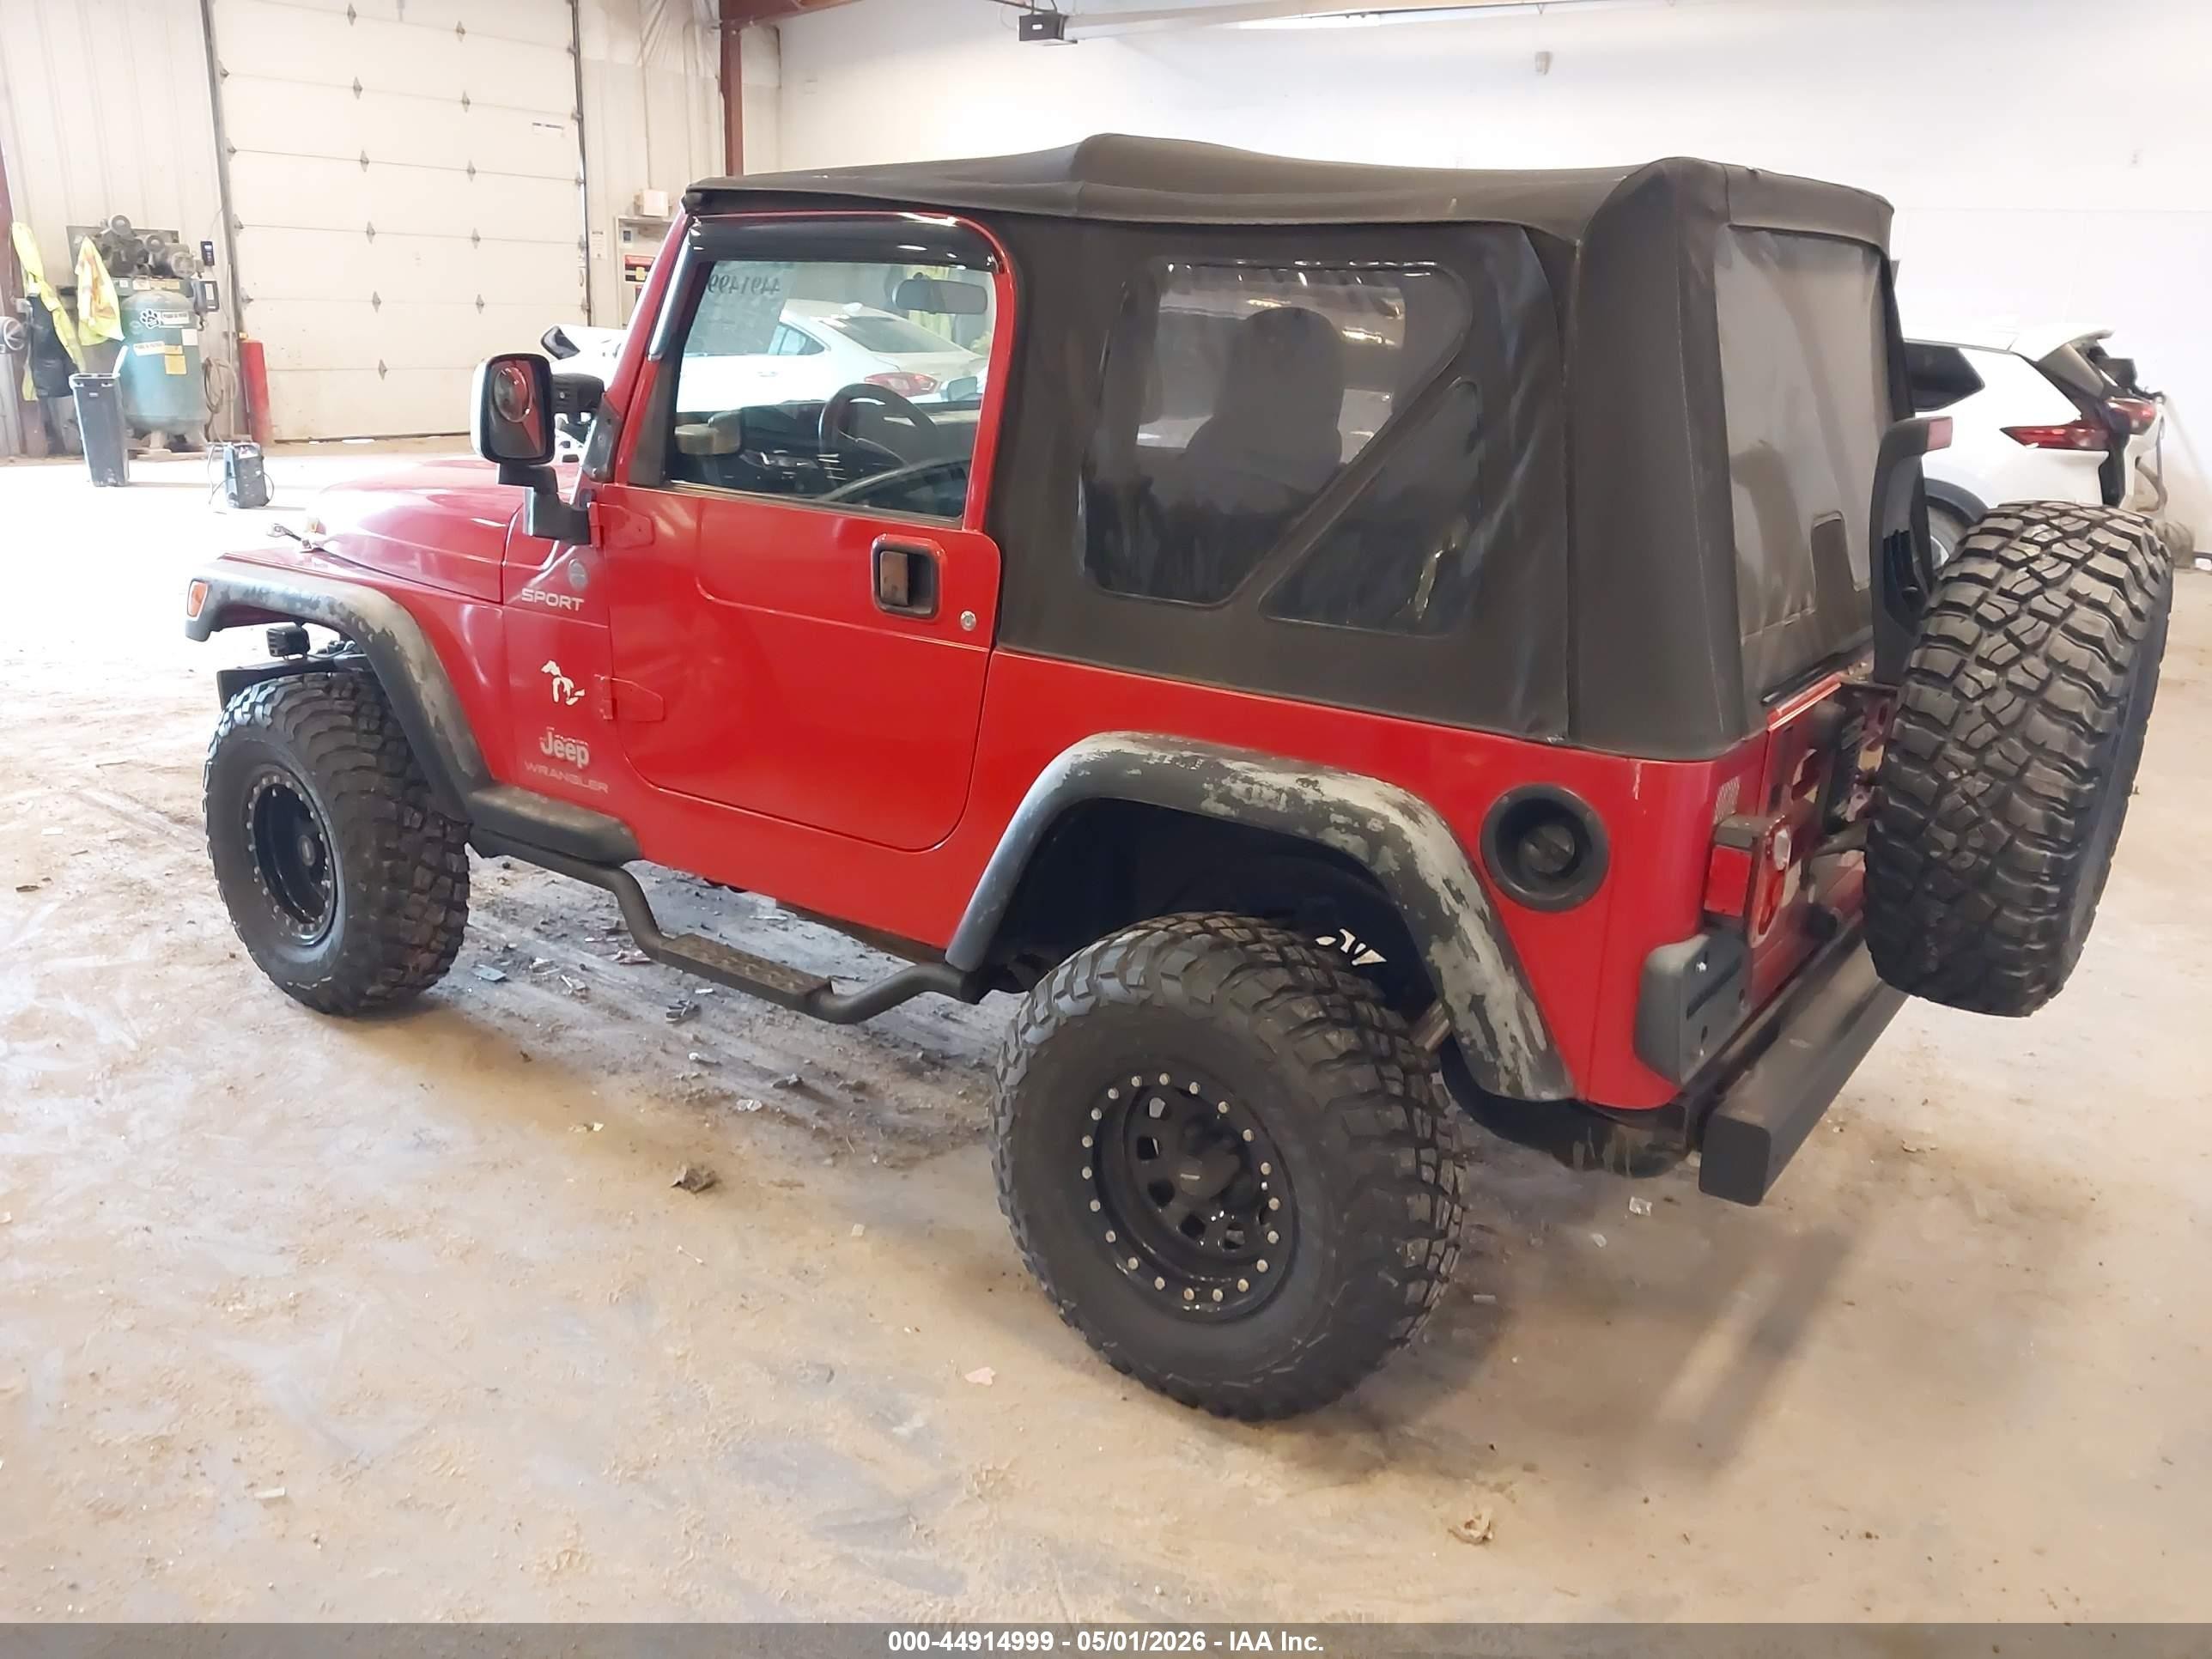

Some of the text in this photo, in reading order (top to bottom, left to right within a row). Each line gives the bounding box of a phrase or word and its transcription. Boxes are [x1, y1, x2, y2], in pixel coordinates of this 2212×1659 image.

[521, 587, 585, 611] SPORT
[539, 726, 590, 769] Jeep
[524, 760, 609, 793] WRANGLER
